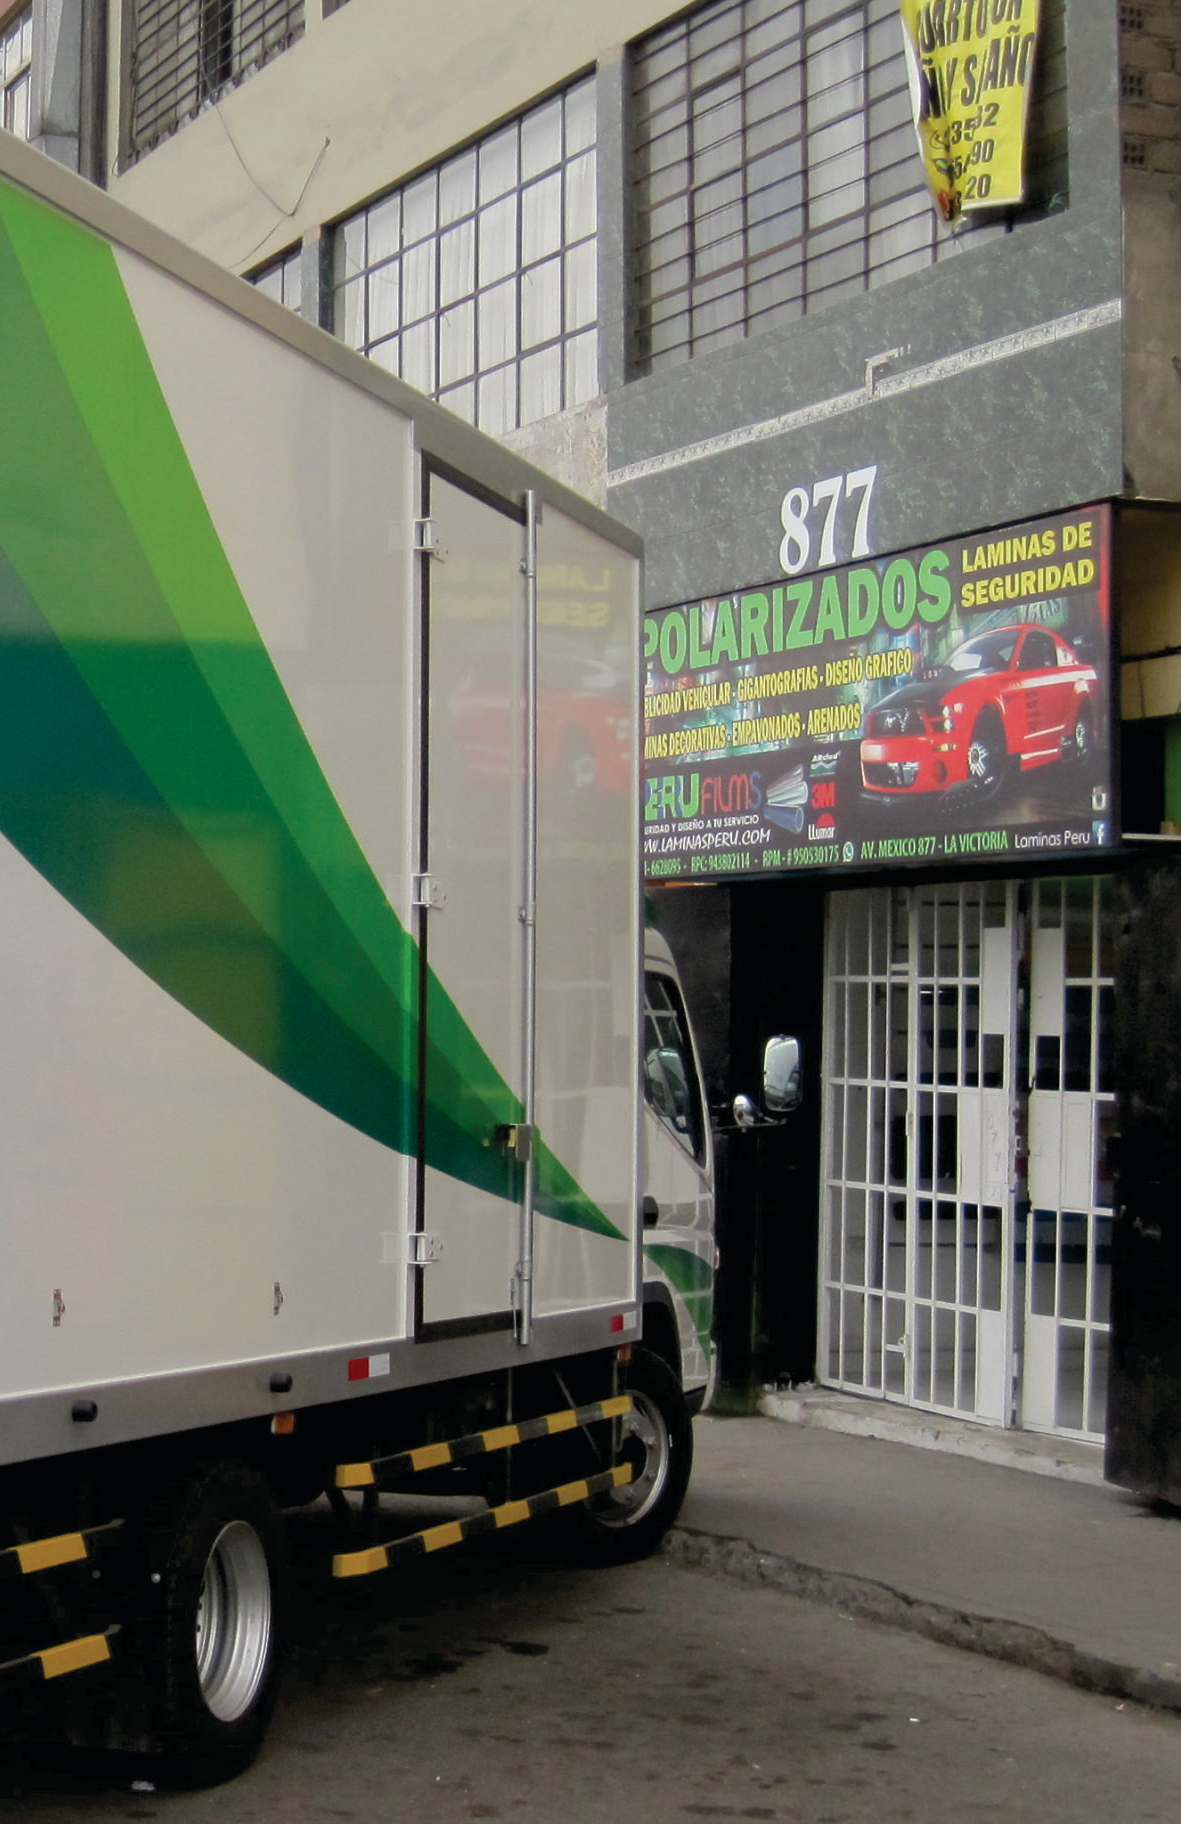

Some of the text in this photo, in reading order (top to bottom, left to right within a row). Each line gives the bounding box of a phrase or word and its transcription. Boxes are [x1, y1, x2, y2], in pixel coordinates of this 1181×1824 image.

[779, 465, 877, 574] 877
[962, 521, 1093, 573] LAMINAS DE
[961, 558, 1095, 608] SEGURIDAD
[644, 549, 952, 674] POLARIZADOS
[682, 681, 732, 711] VEHICULAR
[865, 647, 913, 680] GRAFICO
[669, 726, 726, 755] DECORATIVAS
[732, 712, 801, 747] EMPAVONADOS
[807, 702, 862, 736] ARENADOS
[724, 814, 759, 827] SERVICIO
[811, 782, 836, 809] 3M
[879, 838, 916, 858] MEXICO
[918, 836, 937, 855] 877
[944, 834, 959, 853] LA
[960, 830, 1008, 852] VICTORIA
[1064, 830, 1090, 845] Peru
